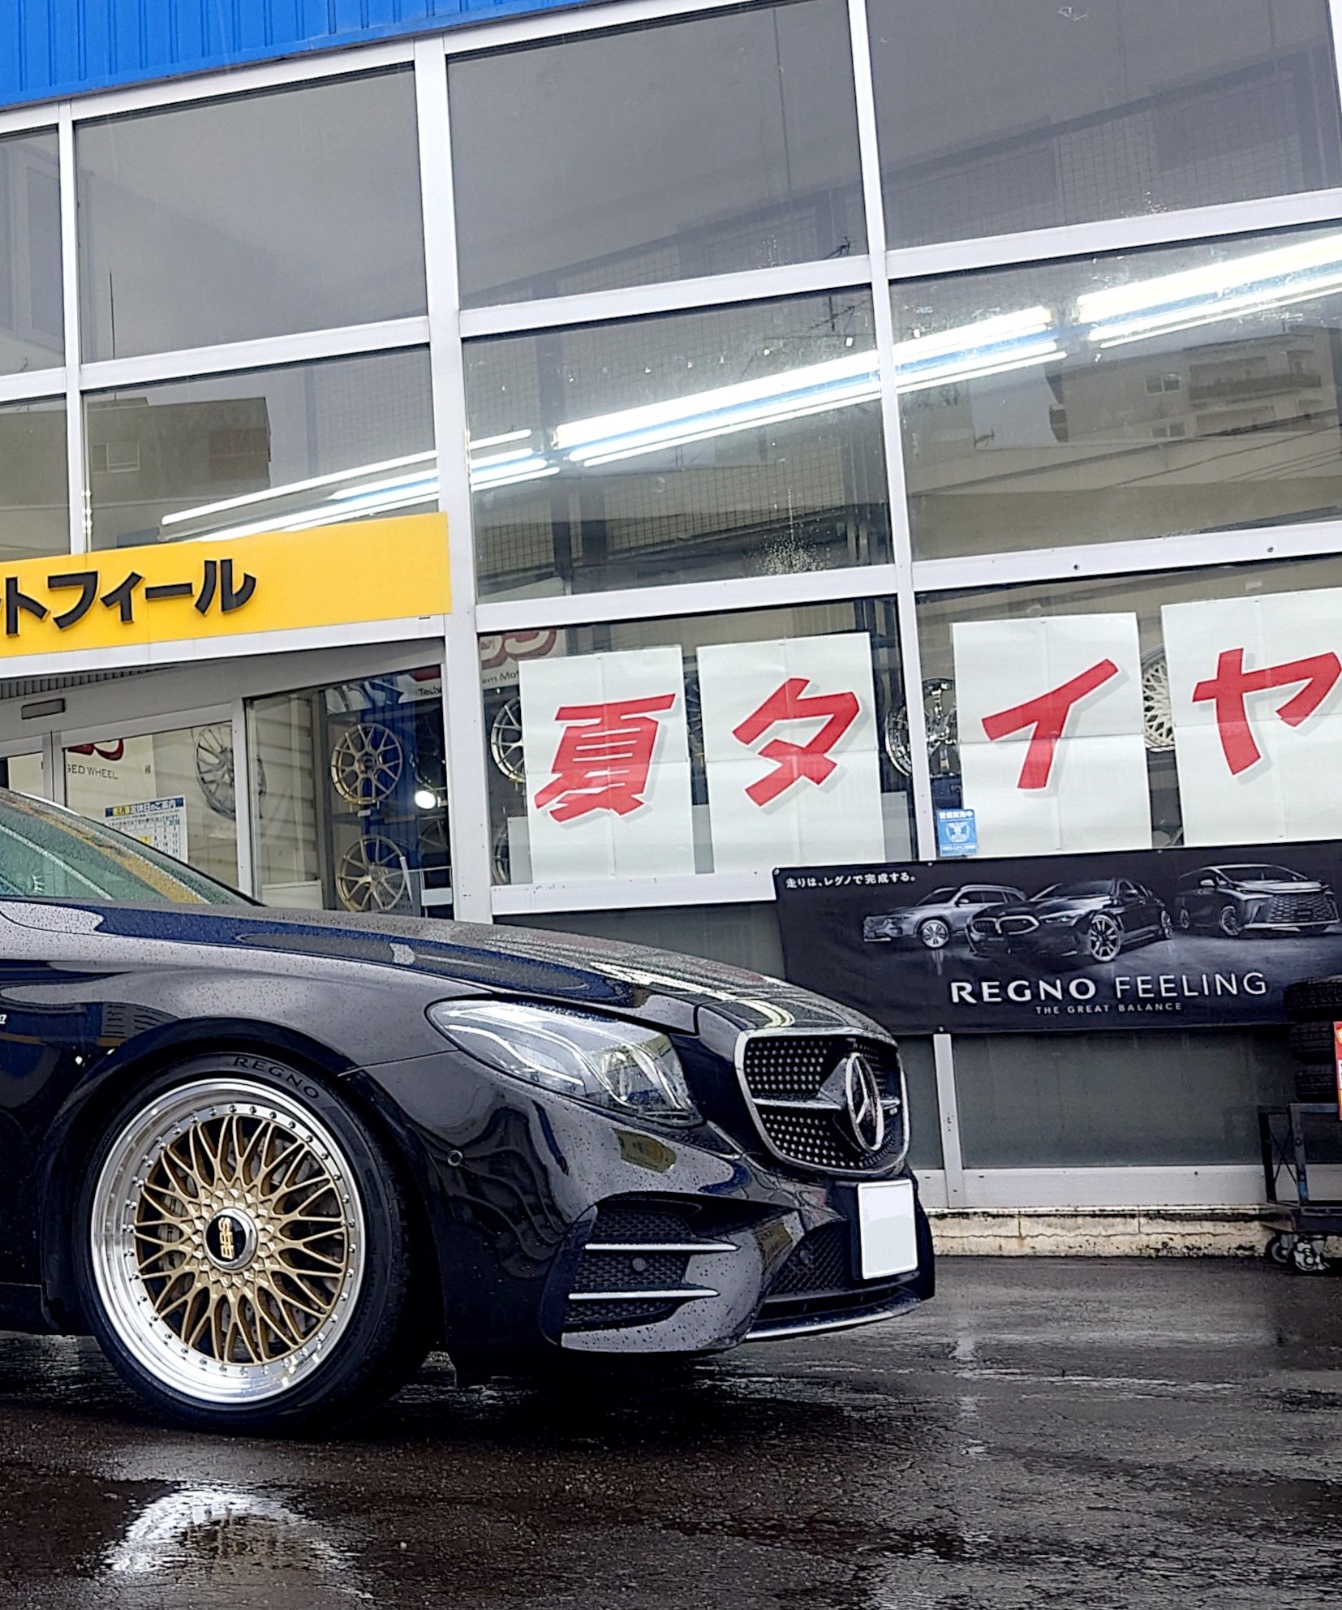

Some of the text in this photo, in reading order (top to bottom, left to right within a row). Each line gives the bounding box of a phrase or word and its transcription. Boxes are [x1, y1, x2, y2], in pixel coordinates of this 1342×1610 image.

[87, 766, 119, 780] WHEEL
[785, 872, 915, 889] 走りは、レグノで完成する。
[950, 972, 1267, 1004] REGNO FEELING
[1035, 1002, 1183, 1014] THE GREAT BALANCE
[233, 1056, 320, 1099] REGNO
[218, 1216, 236, 1260] BBS
